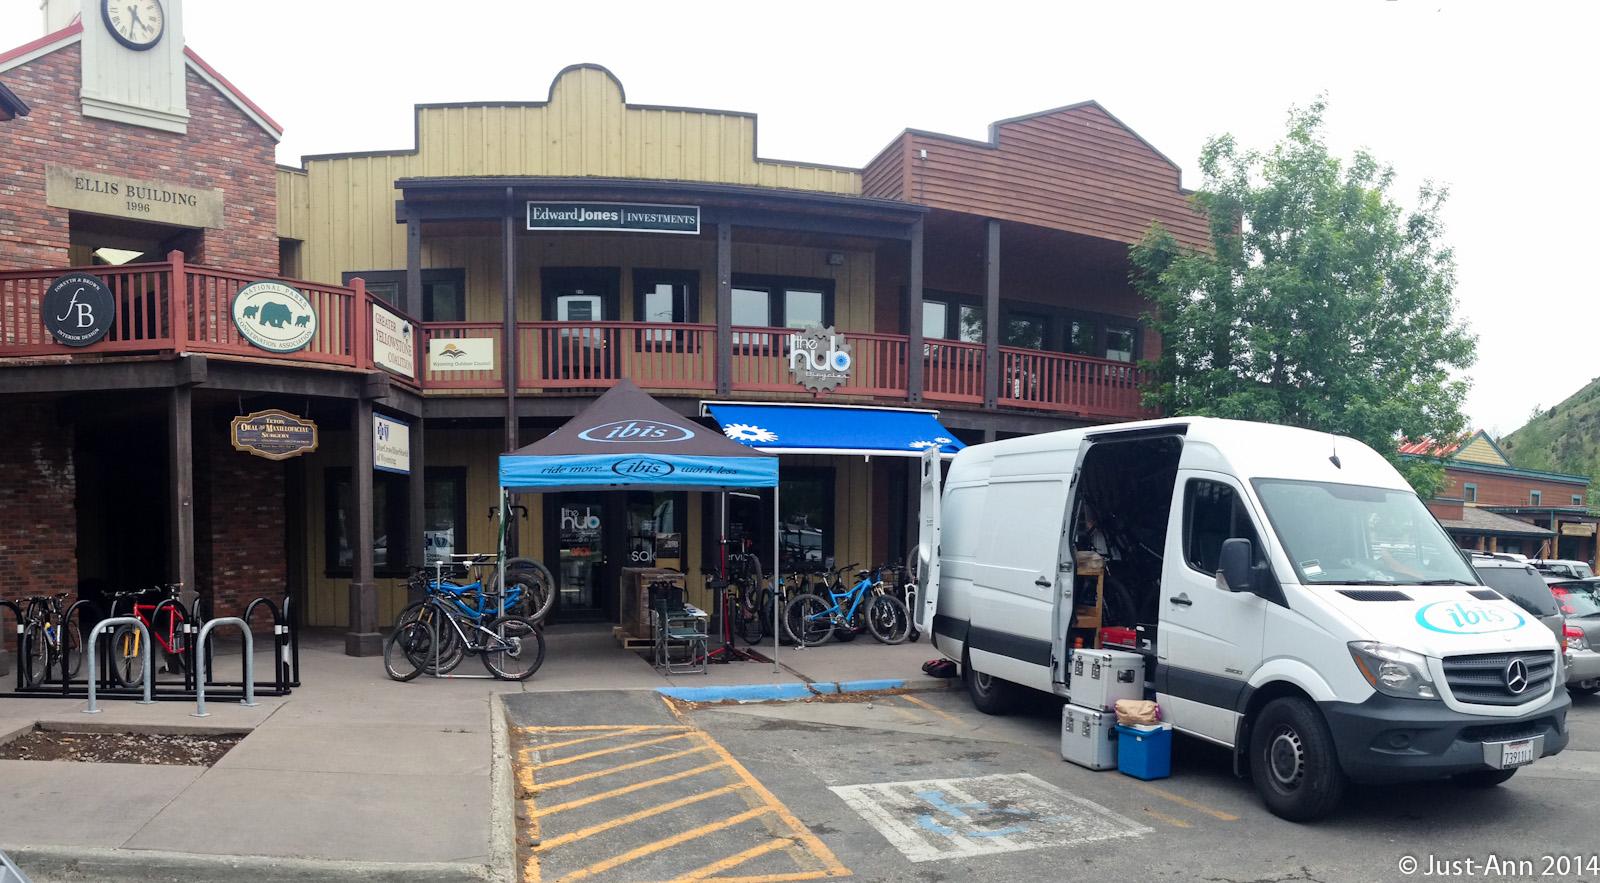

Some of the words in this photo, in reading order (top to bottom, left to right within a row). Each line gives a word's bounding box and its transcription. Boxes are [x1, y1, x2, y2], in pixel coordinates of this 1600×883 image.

[75, 177, 119, 195] ELLIS
[126, 185, 197, 207] BUILDING
[126, 201, 150, 213] 1996
[627, 212, 695, 224] INVESTMENTS
[54, 278, 77, 292] FORSYTH
[82, 278, 100, 291] BROWN
[243, 285, 281, 297] NATIONAL
[285, 288, 307, 308] PARKS
[375, 312, 397, 332] GREATER
[57, 329, 81, 341] INTERIOR
[81, 328, 100, 340] DESIGN
[237, 317, 277, 348] CONSERVATION
[278, 330, 312, 349] ASSOCIATION
[375, 328, 412, 358] YELLOWSTONE
[794, 335, 818, 350] the
[789, 333, 852, 372] hub
[387, 351, 413, 371] COALITION
[240, 423, 258, 432] ORAL
[265, 424, 309, 433] MAXILLOFACIAL
[261, 431, 290, 439] SURGERY
[605, 422, 668, 439] ibis
[541, 465, 568, 475] ride
[626, 460, 660, 474] ibis
[681, 466, 714, 475] work
[715, 465, 738, 475] less
[561, 507, 600, 530] hub
[1446, 603, 1504, 628] ibis
